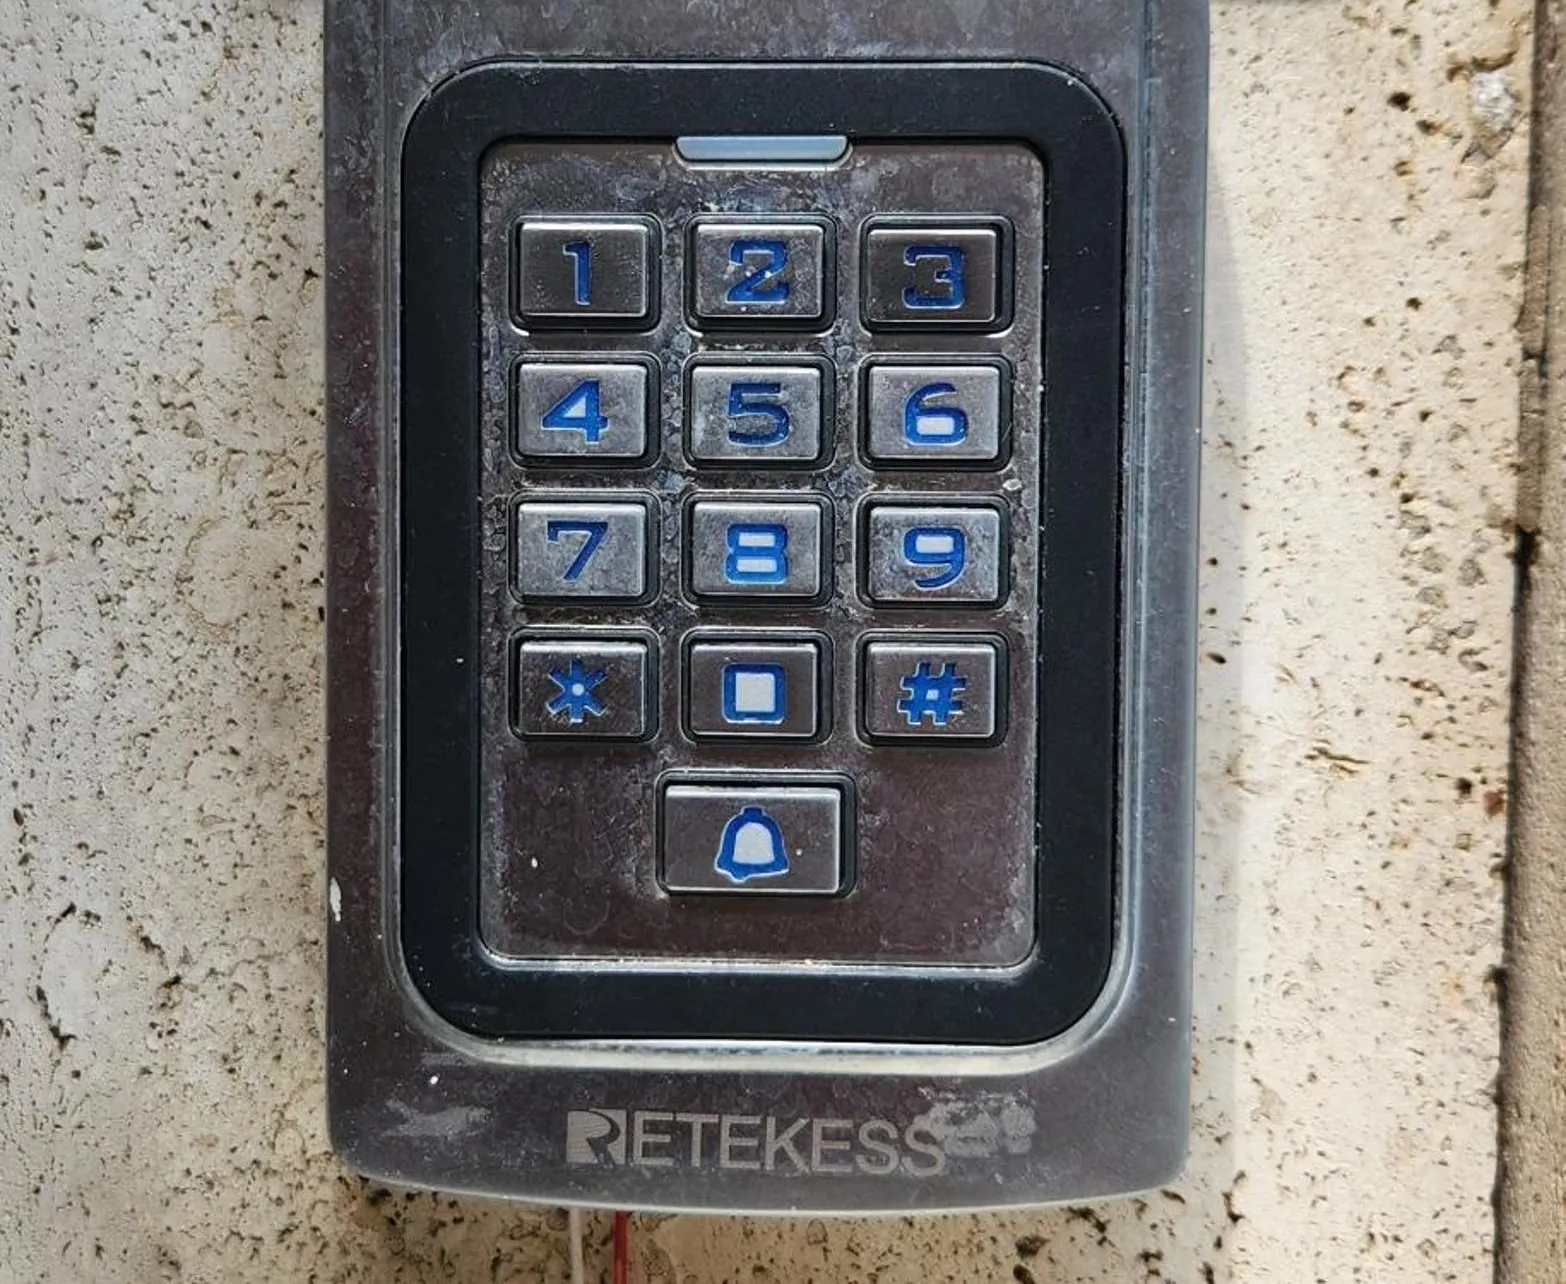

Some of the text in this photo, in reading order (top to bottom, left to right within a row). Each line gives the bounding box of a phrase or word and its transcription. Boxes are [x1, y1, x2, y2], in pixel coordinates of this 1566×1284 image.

[563, 240, 592, 306] 1
[725, 239, 792, 304] 2
[902, 245, 966, 309] 3
[541, 379, 609, 443] 4
[727, 382, 791, 447] 5
[903, 381, 969, 446] 6
[546, 520, 609, 582] 7
[724, 522, 790, 584] 8
[902, 527, 966, 590] 9
[721, 662, 787, 724] 0
[896, 661, 967, 726] #
[566, 1108, 947, 1178] RETEKESS
